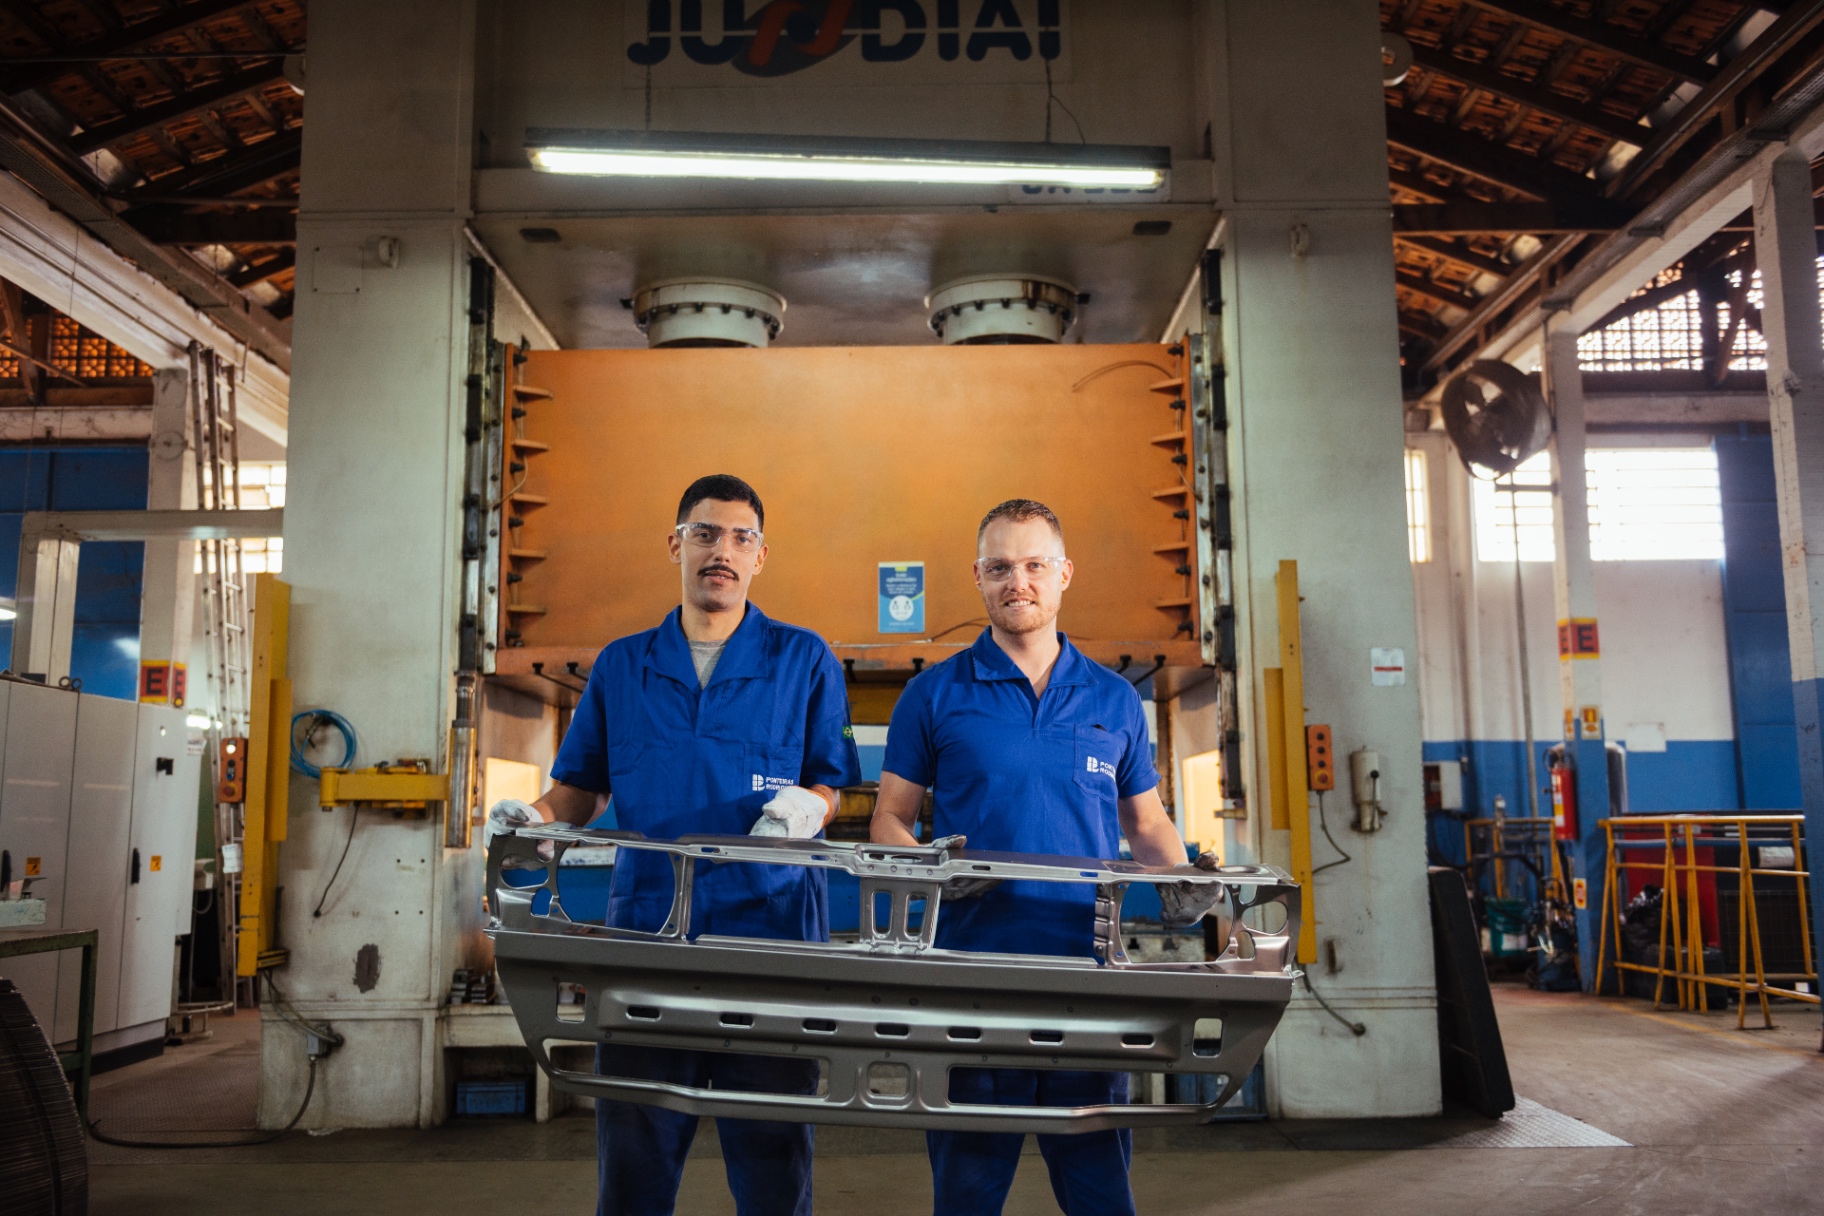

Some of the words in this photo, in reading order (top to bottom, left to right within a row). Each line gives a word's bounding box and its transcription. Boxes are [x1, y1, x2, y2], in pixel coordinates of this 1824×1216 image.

[1578, 625, 1594, 652] E
[146, 668, 163, 695] E
[766, 777, 794, 785] PONTEIRAS
